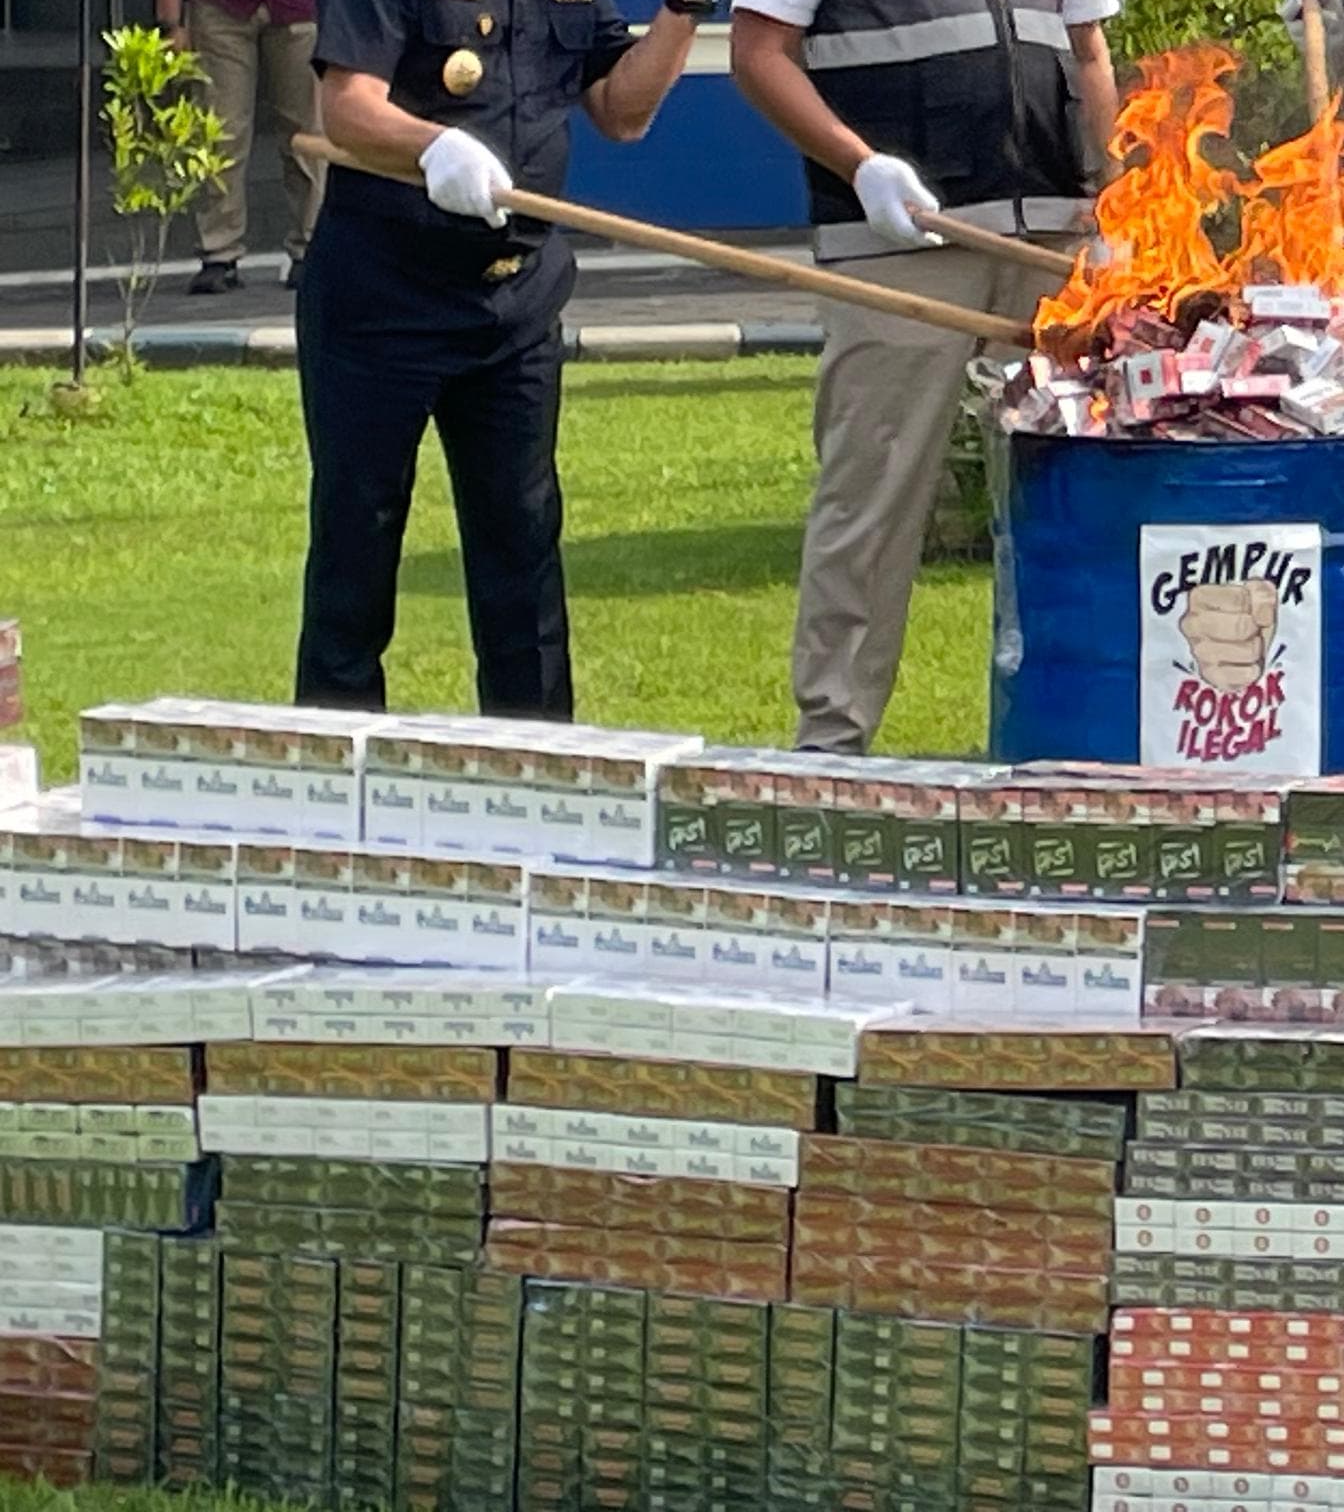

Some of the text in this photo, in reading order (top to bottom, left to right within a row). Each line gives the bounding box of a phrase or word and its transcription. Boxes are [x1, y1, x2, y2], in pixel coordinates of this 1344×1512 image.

[1151, 541, 1311, 615] GEMPUR
[1172, 670, 1287, 729] ROKOK
[1176, 709, 1282, 762] ILEGAL
